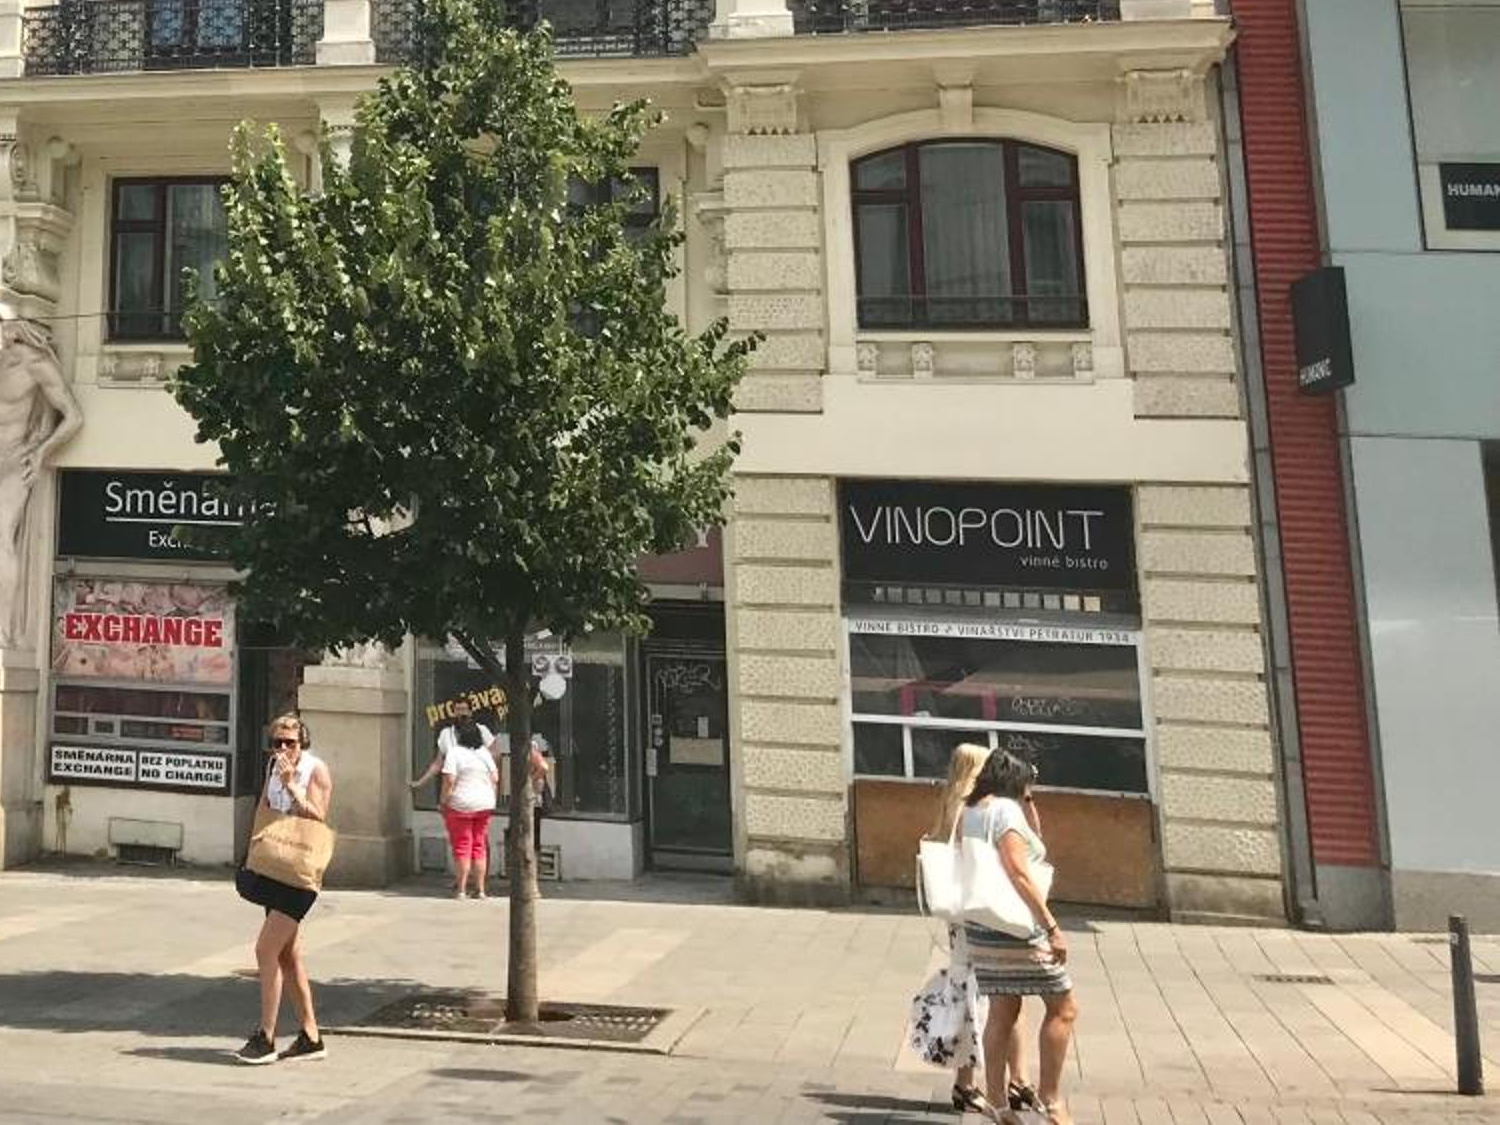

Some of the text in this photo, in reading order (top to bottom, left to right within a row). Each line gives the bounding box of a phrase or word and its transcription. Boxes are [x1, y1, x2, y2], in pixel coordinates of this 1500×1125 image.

[850, 506, 1105, 550] VINOPOINT
[1019, 555, 1109, 570] vinné bistro
[65, 613, 224, 648] EXCHANGE
[53, 762, 133, 777] EXCHANGE
[141, 755, 224, 771] BEZ POPLATKU
[141, 767, 224, 784] NO CHARGE
